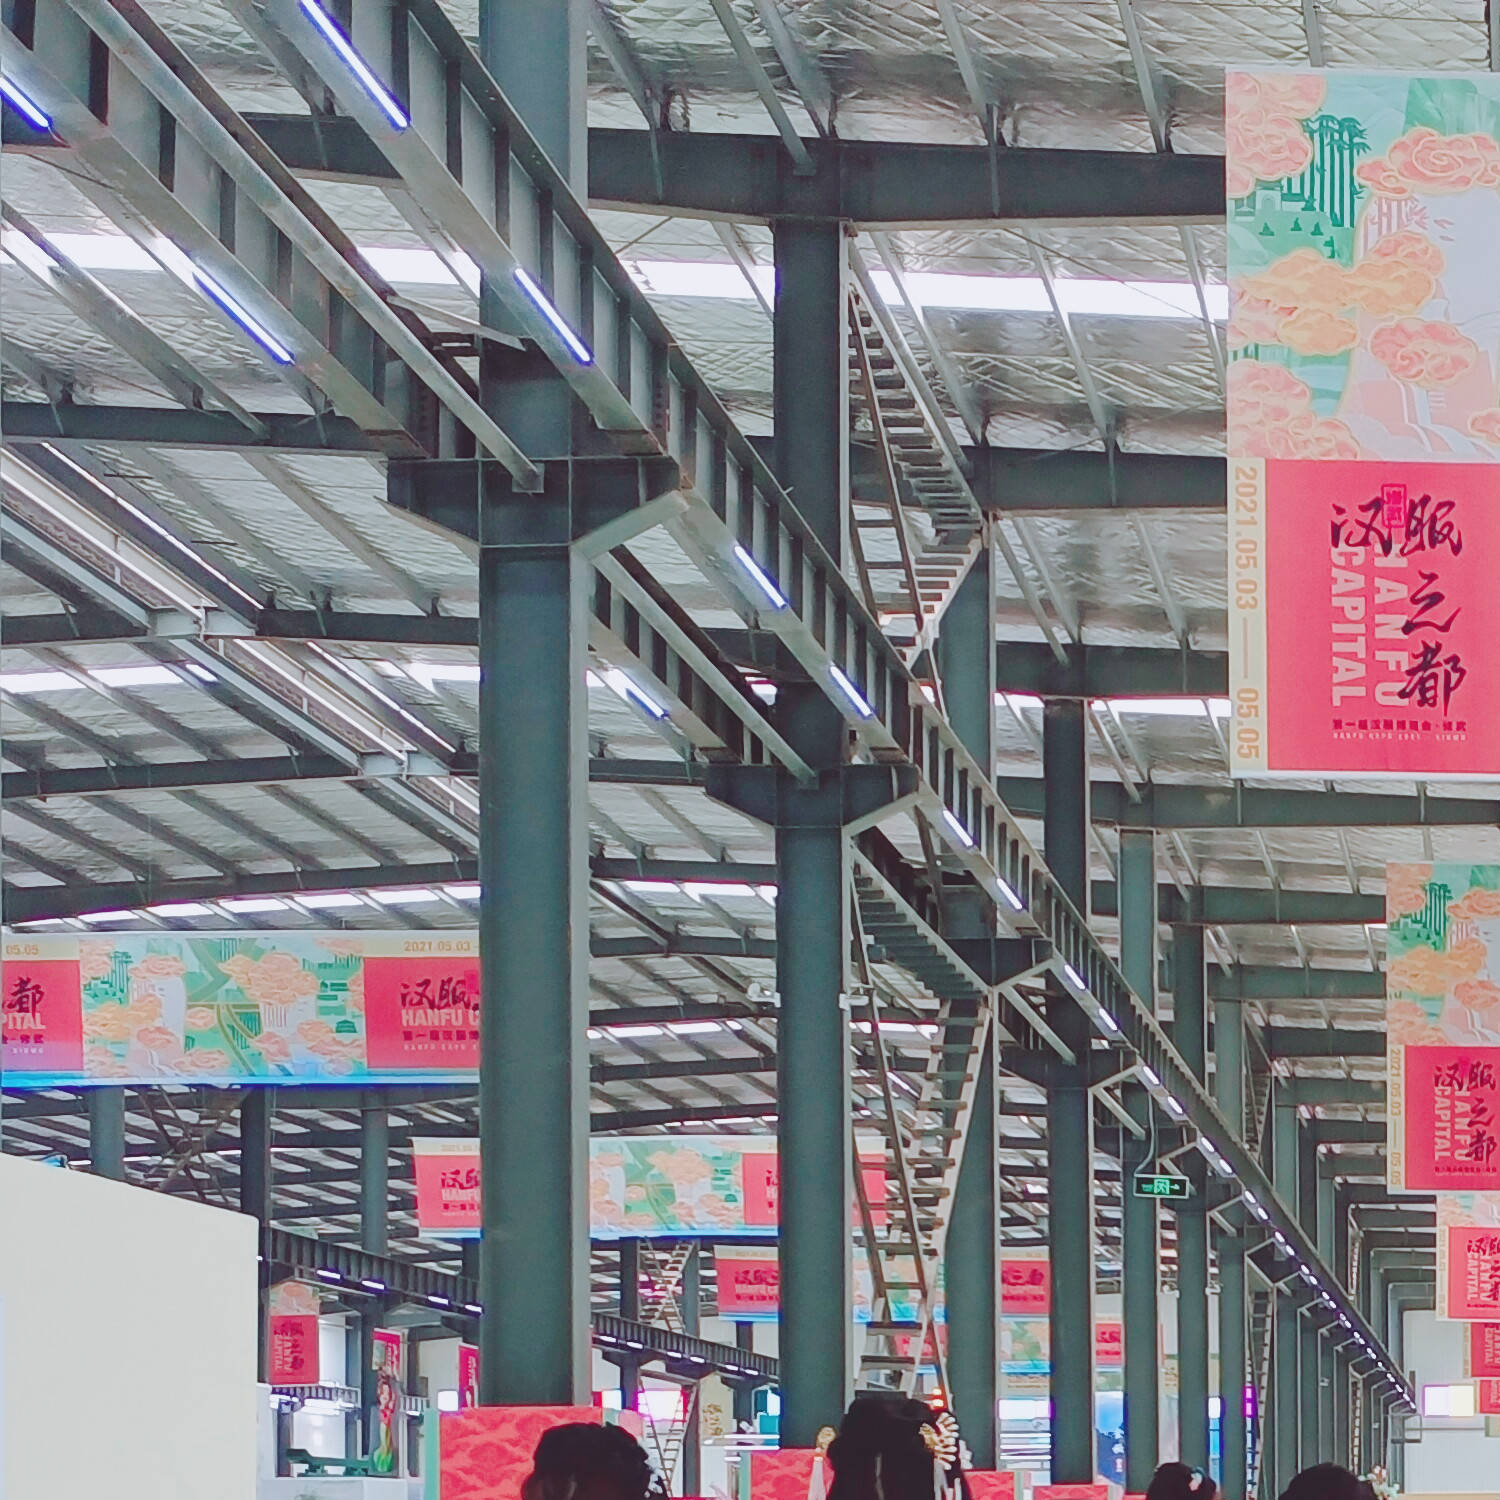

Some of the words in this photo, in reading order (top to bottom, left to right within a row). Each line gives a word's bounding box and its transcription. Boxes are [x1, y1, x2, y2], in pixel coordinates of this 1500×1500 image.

[1234, 466, 1258, 610] 2021.05.03
[1331, 543, 1368, 707] CAPITAL
[1373, 541, 1411, 708] HANFU
[1236, 687, 1260, 759] 05.05
[400, 976, 479, 1012] 汉服
[401, 1009, 464, 1027] HANFU
[1434, 1085, 1452, 1161] CAPITAL
